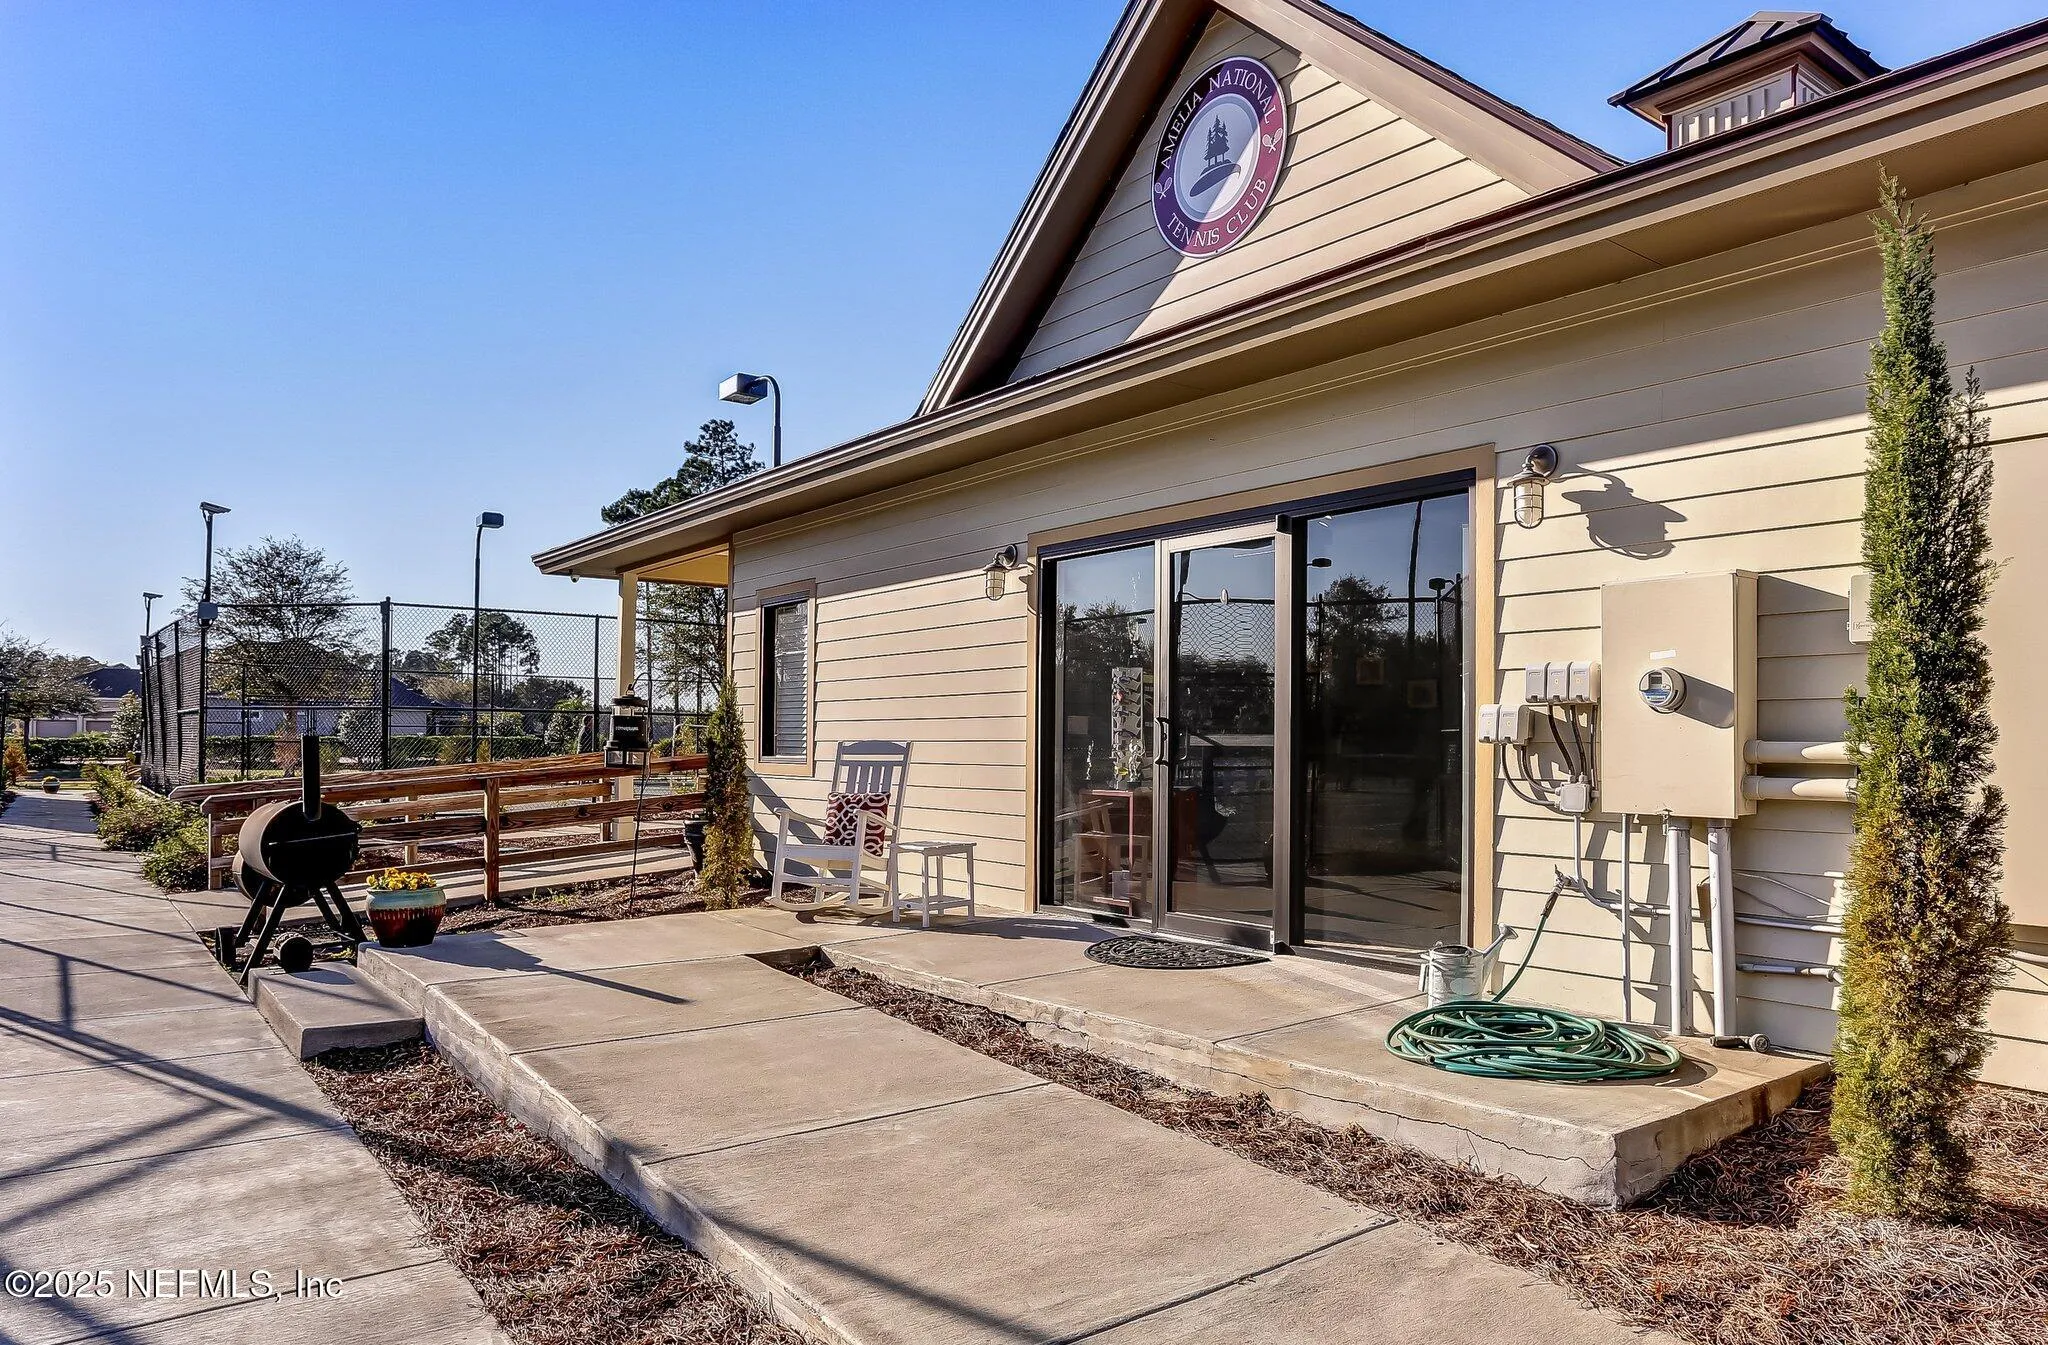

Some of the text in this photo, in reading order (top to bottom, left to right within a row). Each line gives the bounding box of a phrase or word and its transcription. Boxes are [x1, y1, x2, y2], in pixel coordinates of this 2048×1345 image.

[1161, 68, 1277, 169] AMELIA NATIONAL
[1166, 178, 1267, 247] TENNIS CLUB
